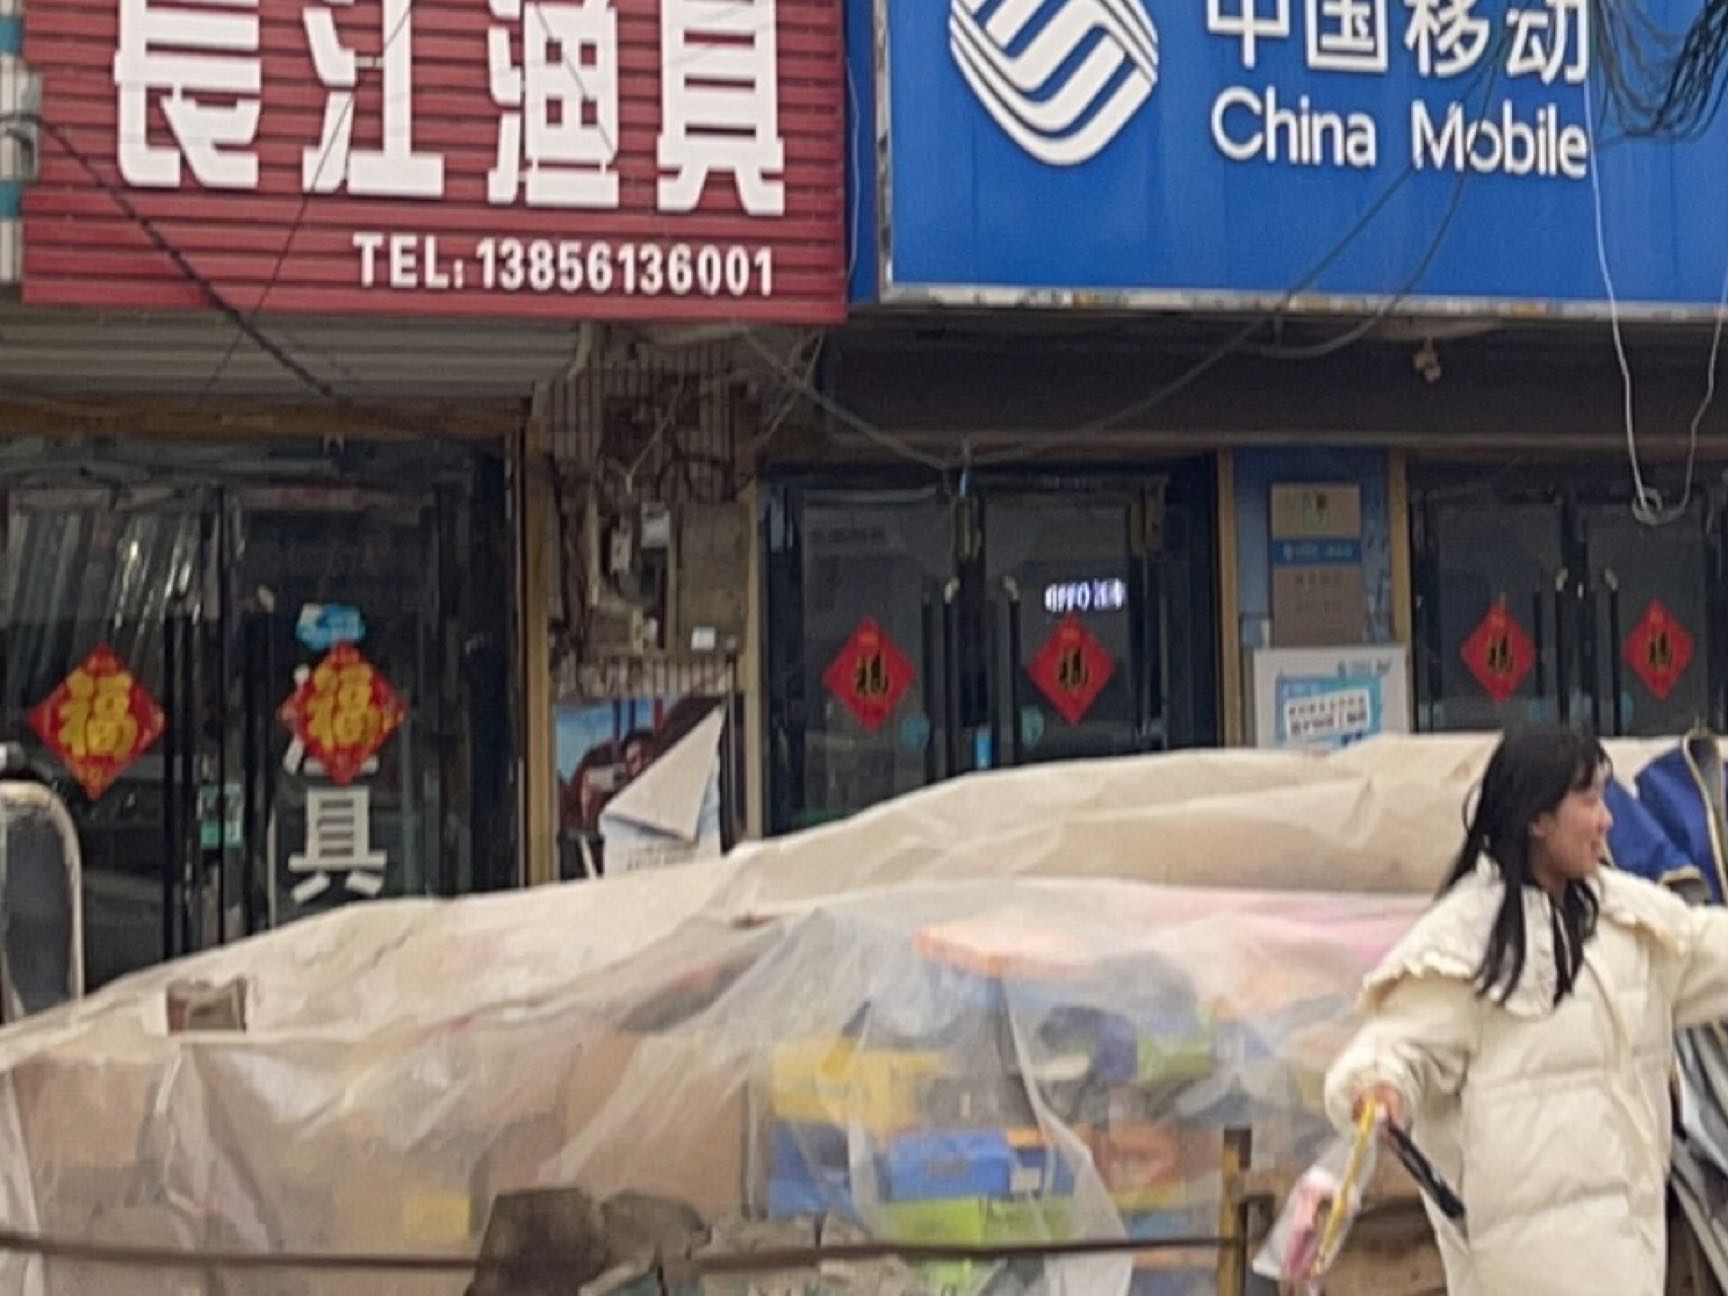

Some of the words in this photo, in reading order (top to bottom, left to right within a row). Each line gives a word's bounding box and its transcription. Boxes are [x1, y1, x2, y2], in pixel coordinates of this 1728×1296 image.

[1210, 84, 1377, 169] China
[1410, 98, 1589, 180] Mobile
[475, 236, 773, 297] 13856136001
[58, 666, 139, 760] 福
[307, 664, 381, 753] 福
